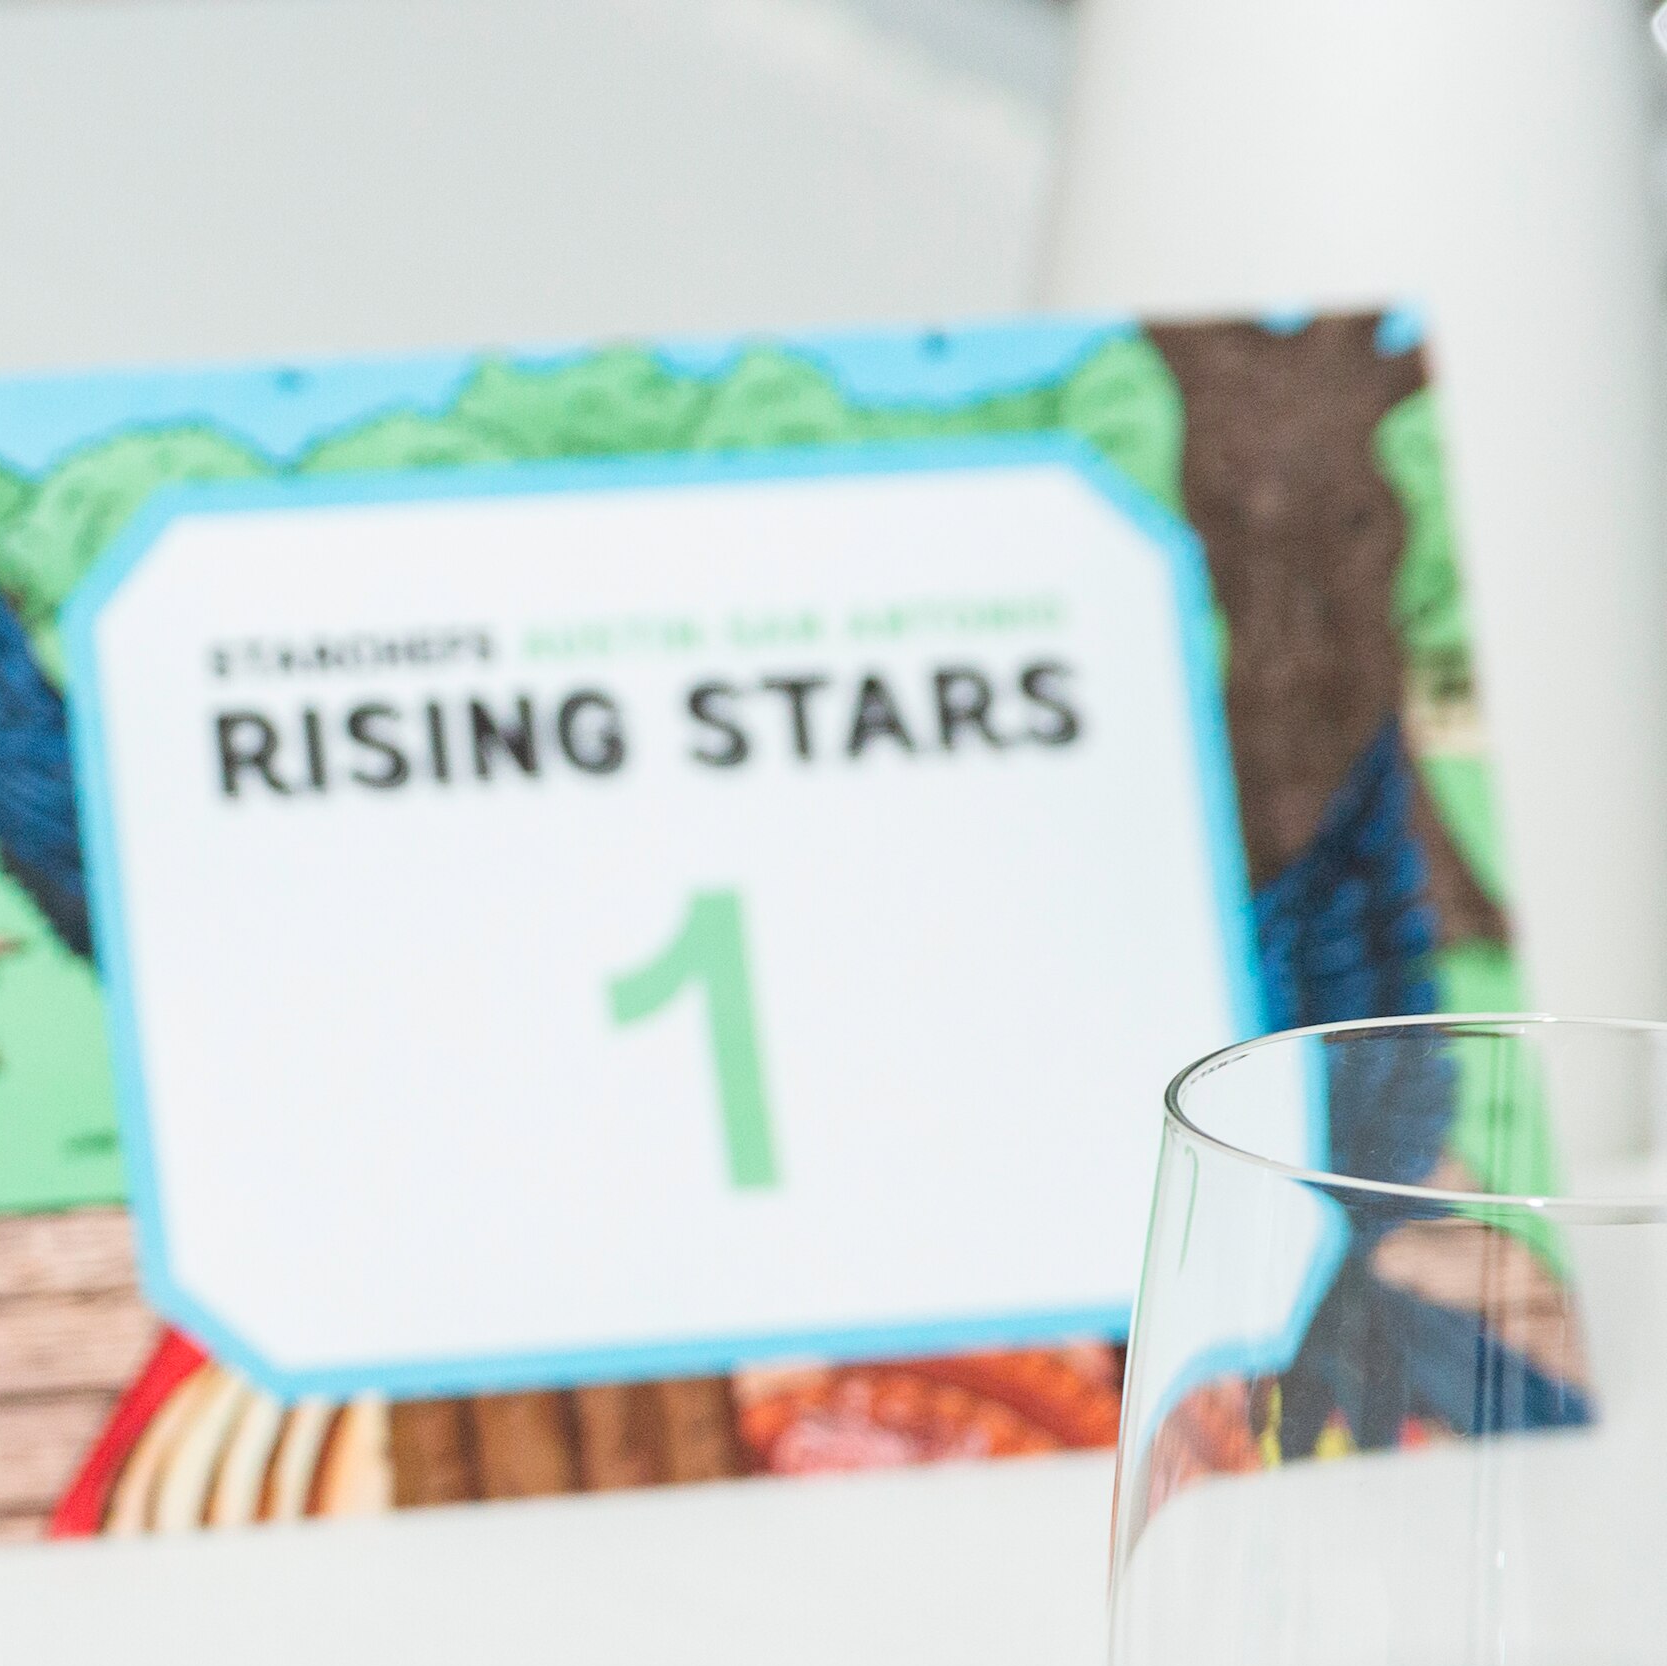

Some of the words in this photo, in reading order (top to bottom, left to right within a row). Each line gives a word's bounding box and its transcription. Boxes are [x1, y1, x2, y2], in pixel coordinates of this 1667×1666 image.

[215, 688, 627, 799] RISING
[686, 661, 1085, 769] STARS
[604, 885, 782, 1193] 1
